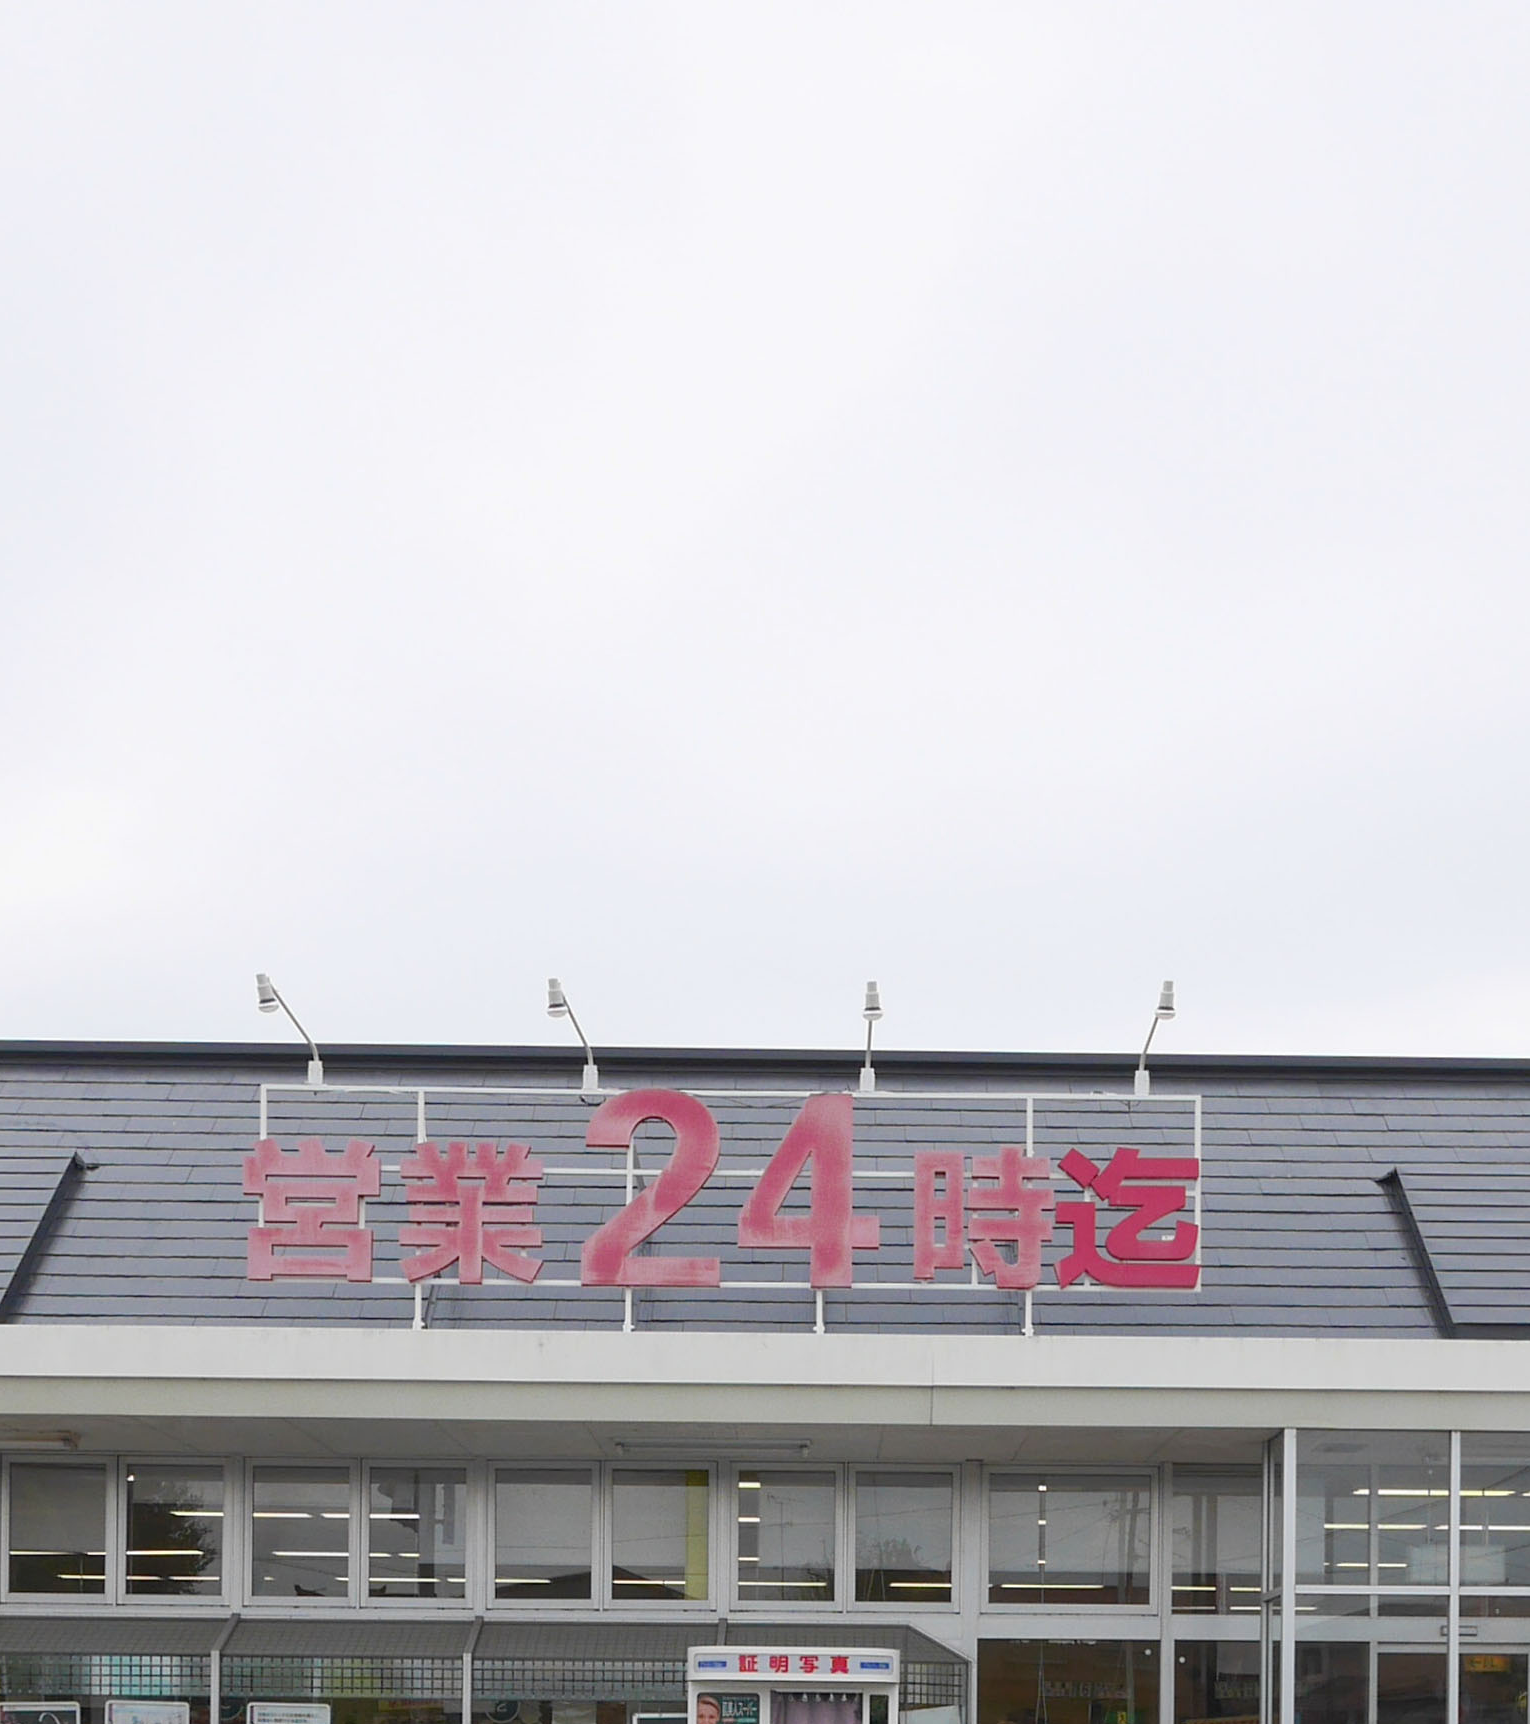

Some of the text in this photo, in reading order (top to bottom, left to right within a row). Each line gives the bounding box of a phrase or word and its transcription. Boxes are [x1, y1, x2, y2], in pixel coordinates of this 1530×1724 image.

[242, 1087, 1201, 1290] 営業24時迄
[738, 1654, 850, 1675] 証明写真
